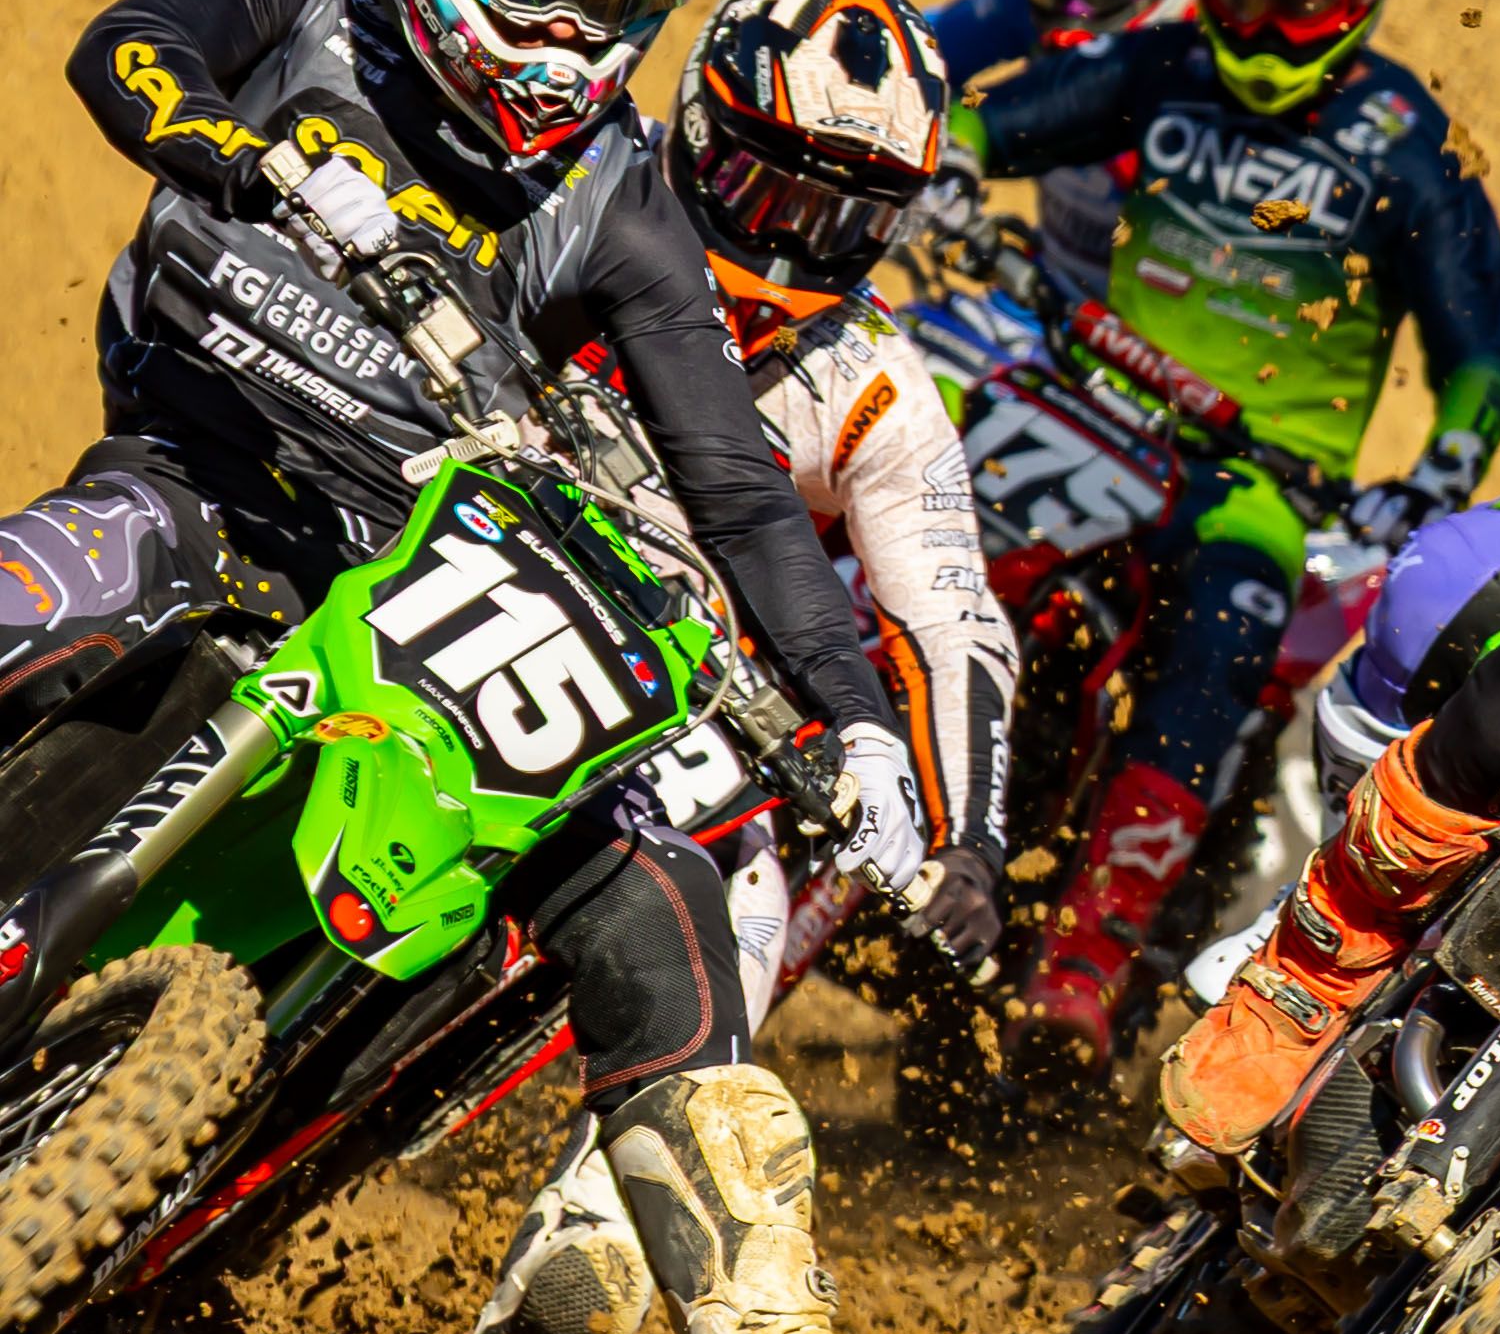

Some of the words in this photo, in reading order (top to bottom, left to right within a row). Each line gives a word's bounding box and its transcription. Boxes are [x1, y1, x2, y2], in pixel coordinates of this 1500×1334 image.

[209, 251, 269, 307] FG
[265, 303, 380, 380] GROUP
[276, 282, 417, 380] FRIESEN
[259, 349, 374, 423] TWISTED
[515, 529, 627, 646] SUPERCROSS
[364, 533, 633, 774] 115
[416, 678, 448, 706] MAX
[442, 700, 485, 751] SANFORD
[439, 902, 476, 928] TWISTED
